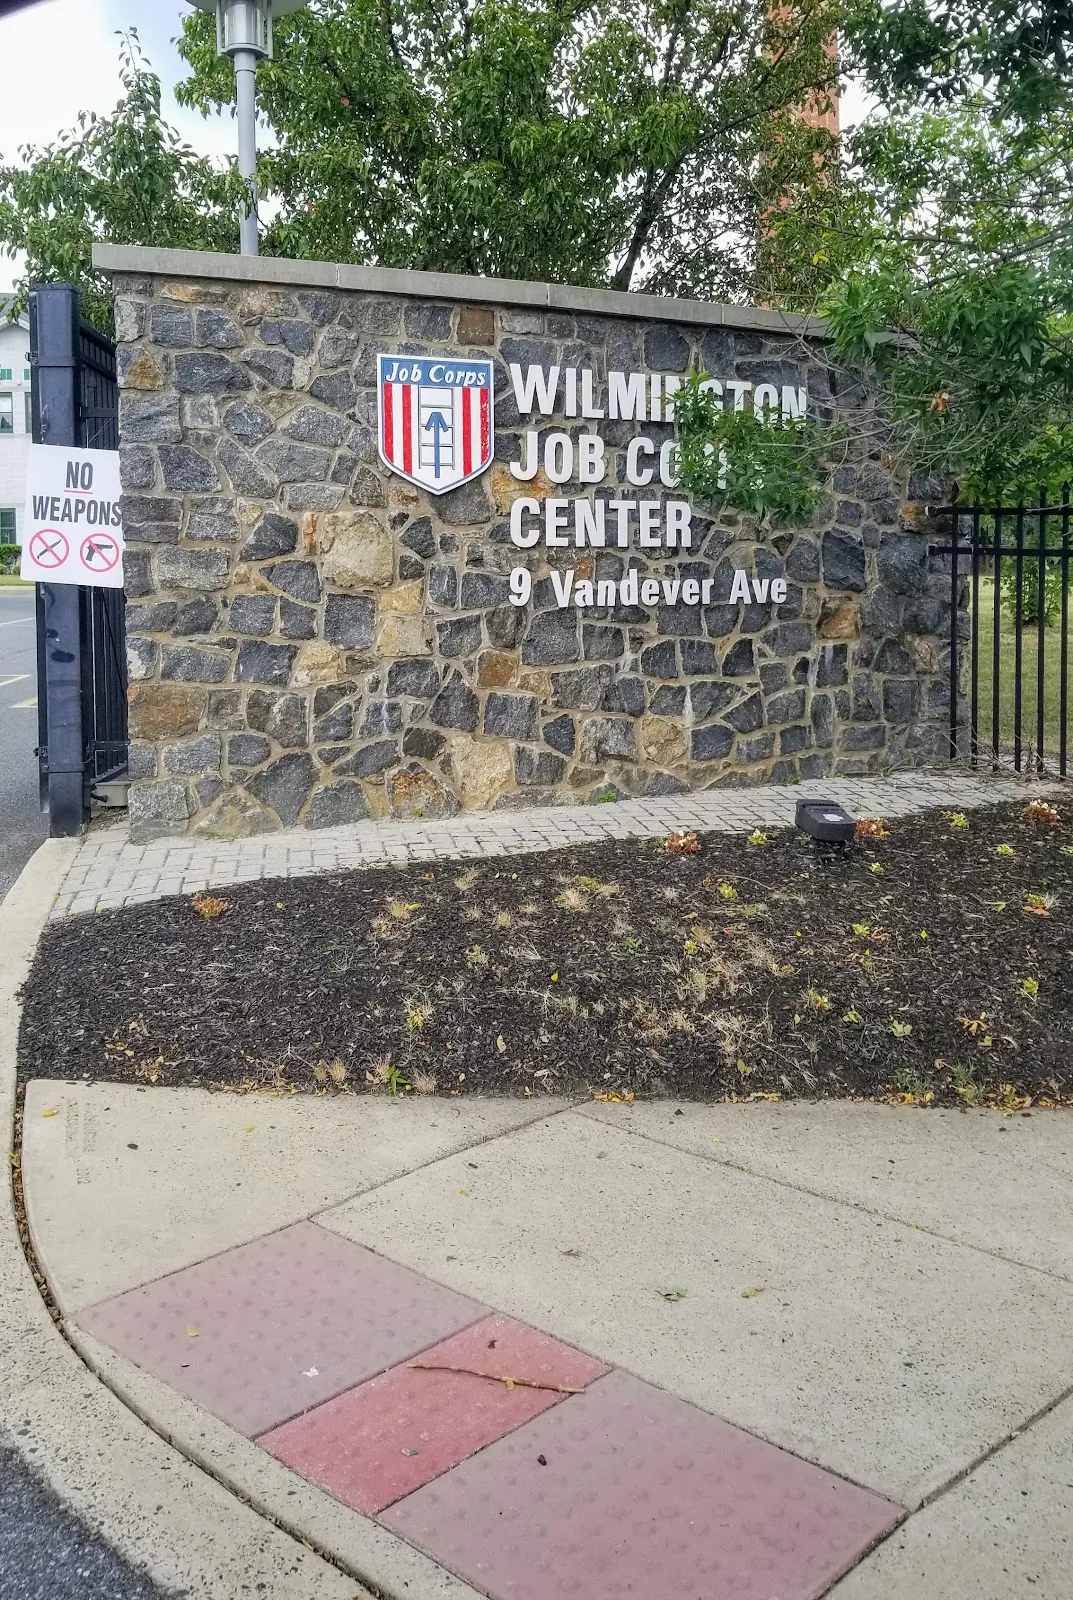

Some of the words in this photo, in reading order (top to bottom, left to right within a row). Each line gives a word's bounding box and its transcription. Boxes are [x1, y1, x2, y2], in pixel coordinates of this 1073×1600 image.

[386, 362, 422, 382] Job
[429, 365, 487, 387] Corps
[65, 461, 94, 490] NO
[509, 431, 605, 484] JOB
[32, 495, 122, 527] WEAPONS
[509, 498, 692, 548] CENTER
[508, 567, 532, 607] 9
[550, 568, 715, 608] Vandever
[729, 569, 787, 605] Ave
